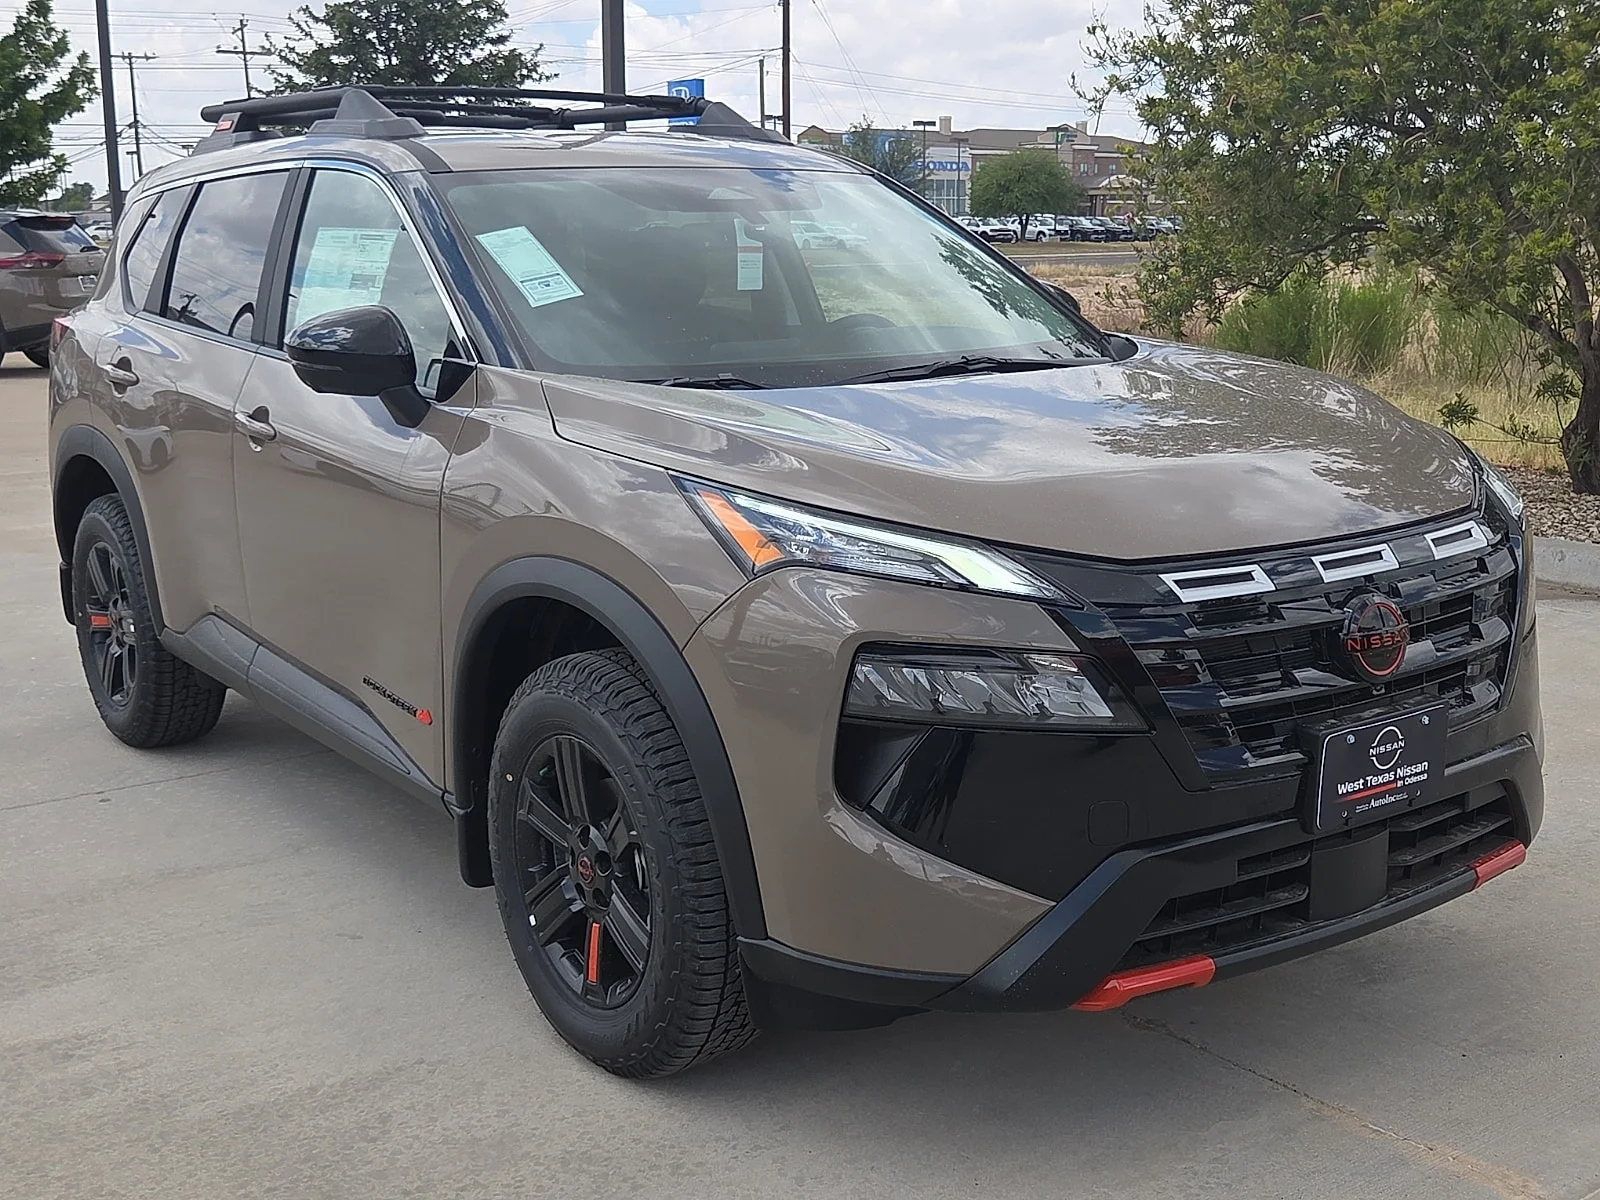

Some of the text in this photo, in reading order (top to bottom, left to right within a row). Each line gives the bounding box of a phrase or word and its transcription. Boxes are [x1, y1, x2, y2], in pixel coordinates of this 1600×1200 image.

[1347, 627, 1410, 652] NISSAN
[1369, 739, 1405, 756] NISSAN
[1337, 761, 1429, 795] West Texas Nissan
[1404, 772, 1428, 786] Odessa
